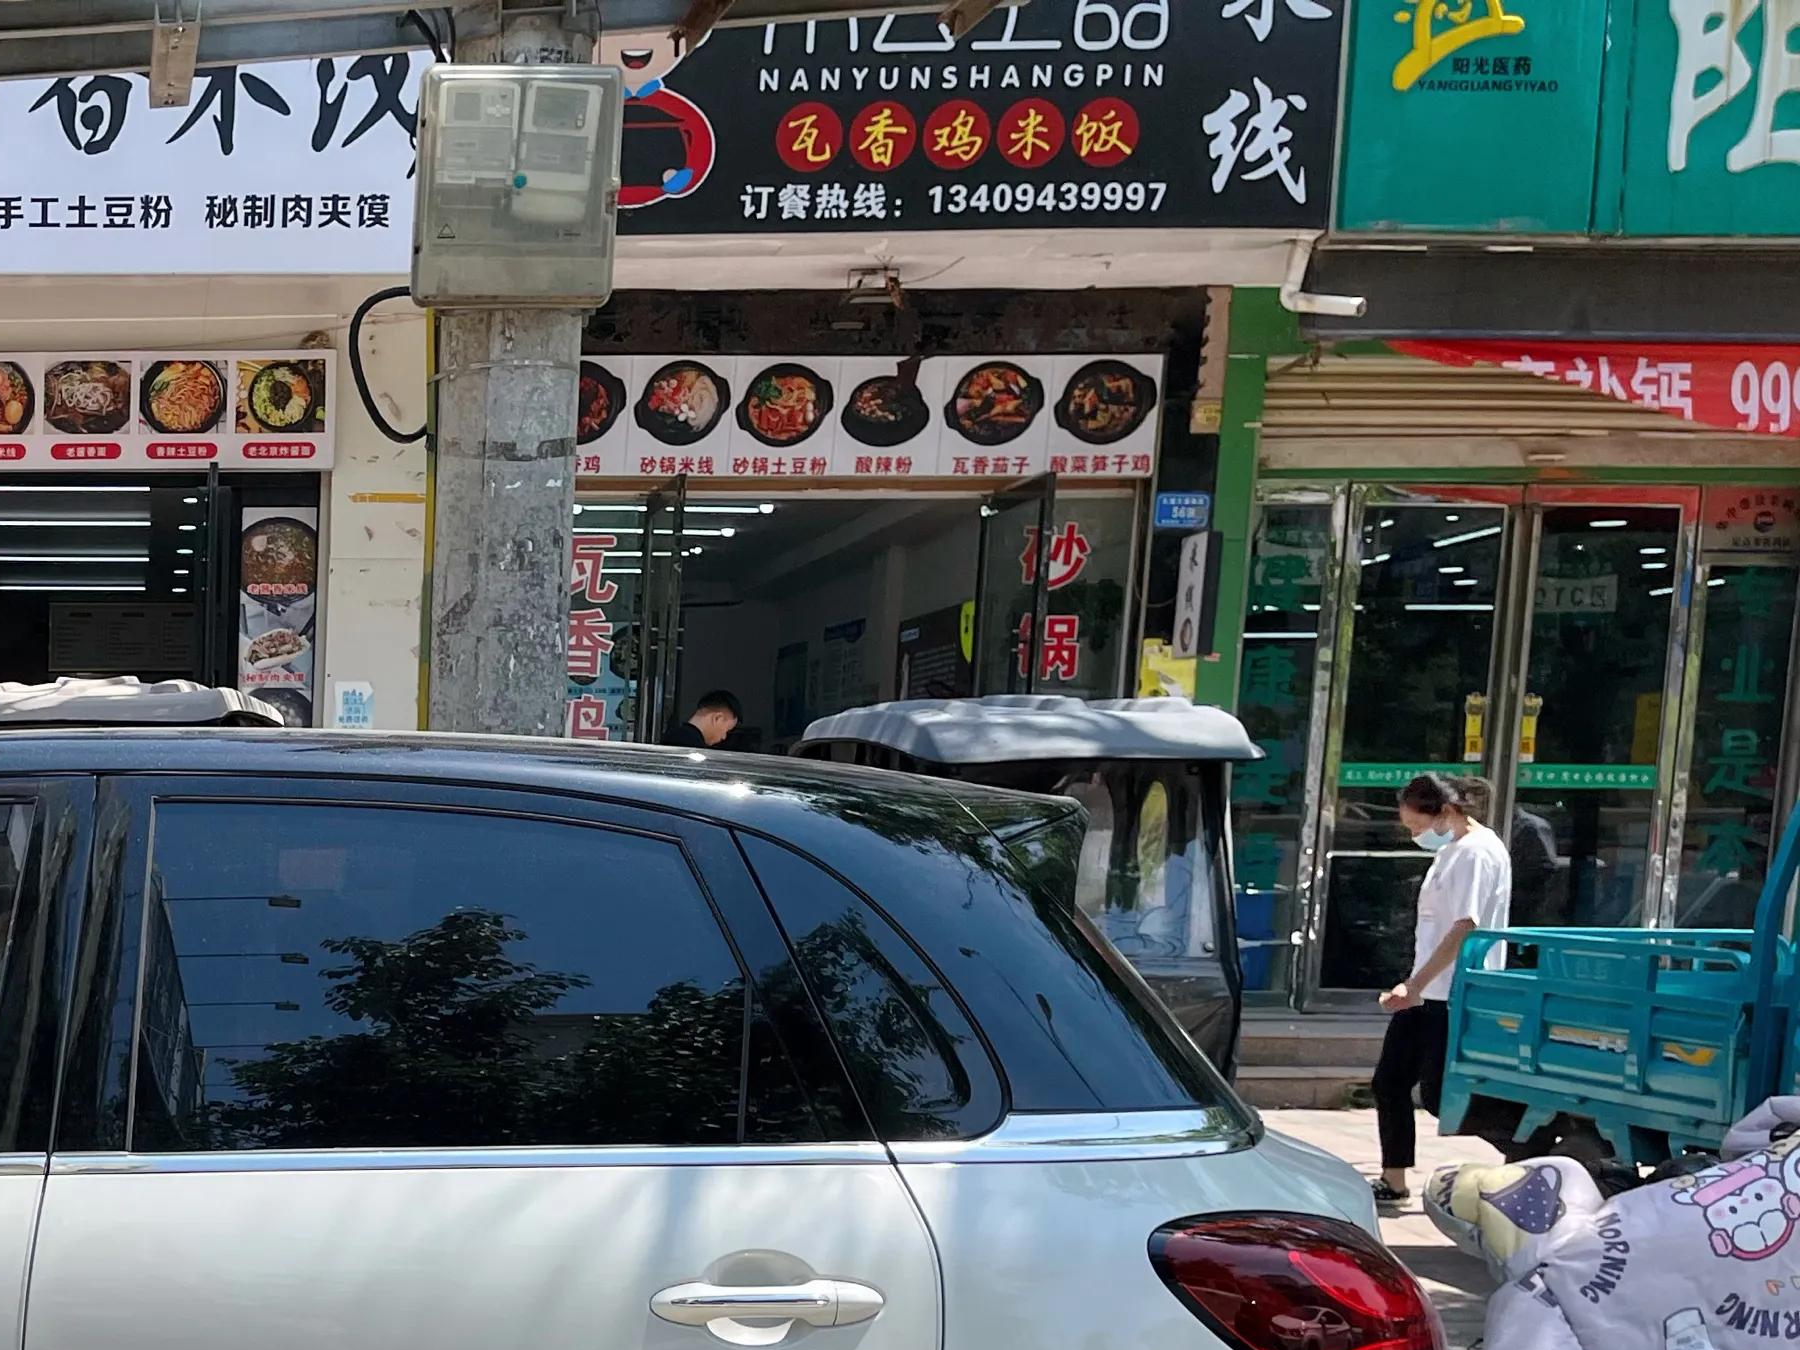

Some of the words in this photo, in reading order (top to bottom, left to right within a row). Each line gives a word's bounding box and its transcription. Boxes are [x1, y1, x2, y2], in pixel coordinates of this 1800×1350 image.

[1453, 56, 1532, 76] 阳光医药
[759, 63, 1165, 92] NANYUNSHANGPIN
[788, 108, 1133, 168] 瓦香鸡米饭
[927, 182, 1168, 214] 13409439997
[204, 194, 393, 230] 秘制肉夹馍
[640, 456, 714, 475] 砂锅米线
[733, 456, 827, 476] 砂锅土豆粉
[855, 456, 912, 474] 酸辣粉
[952, 456, 1030, 475] 瓦香茄子
